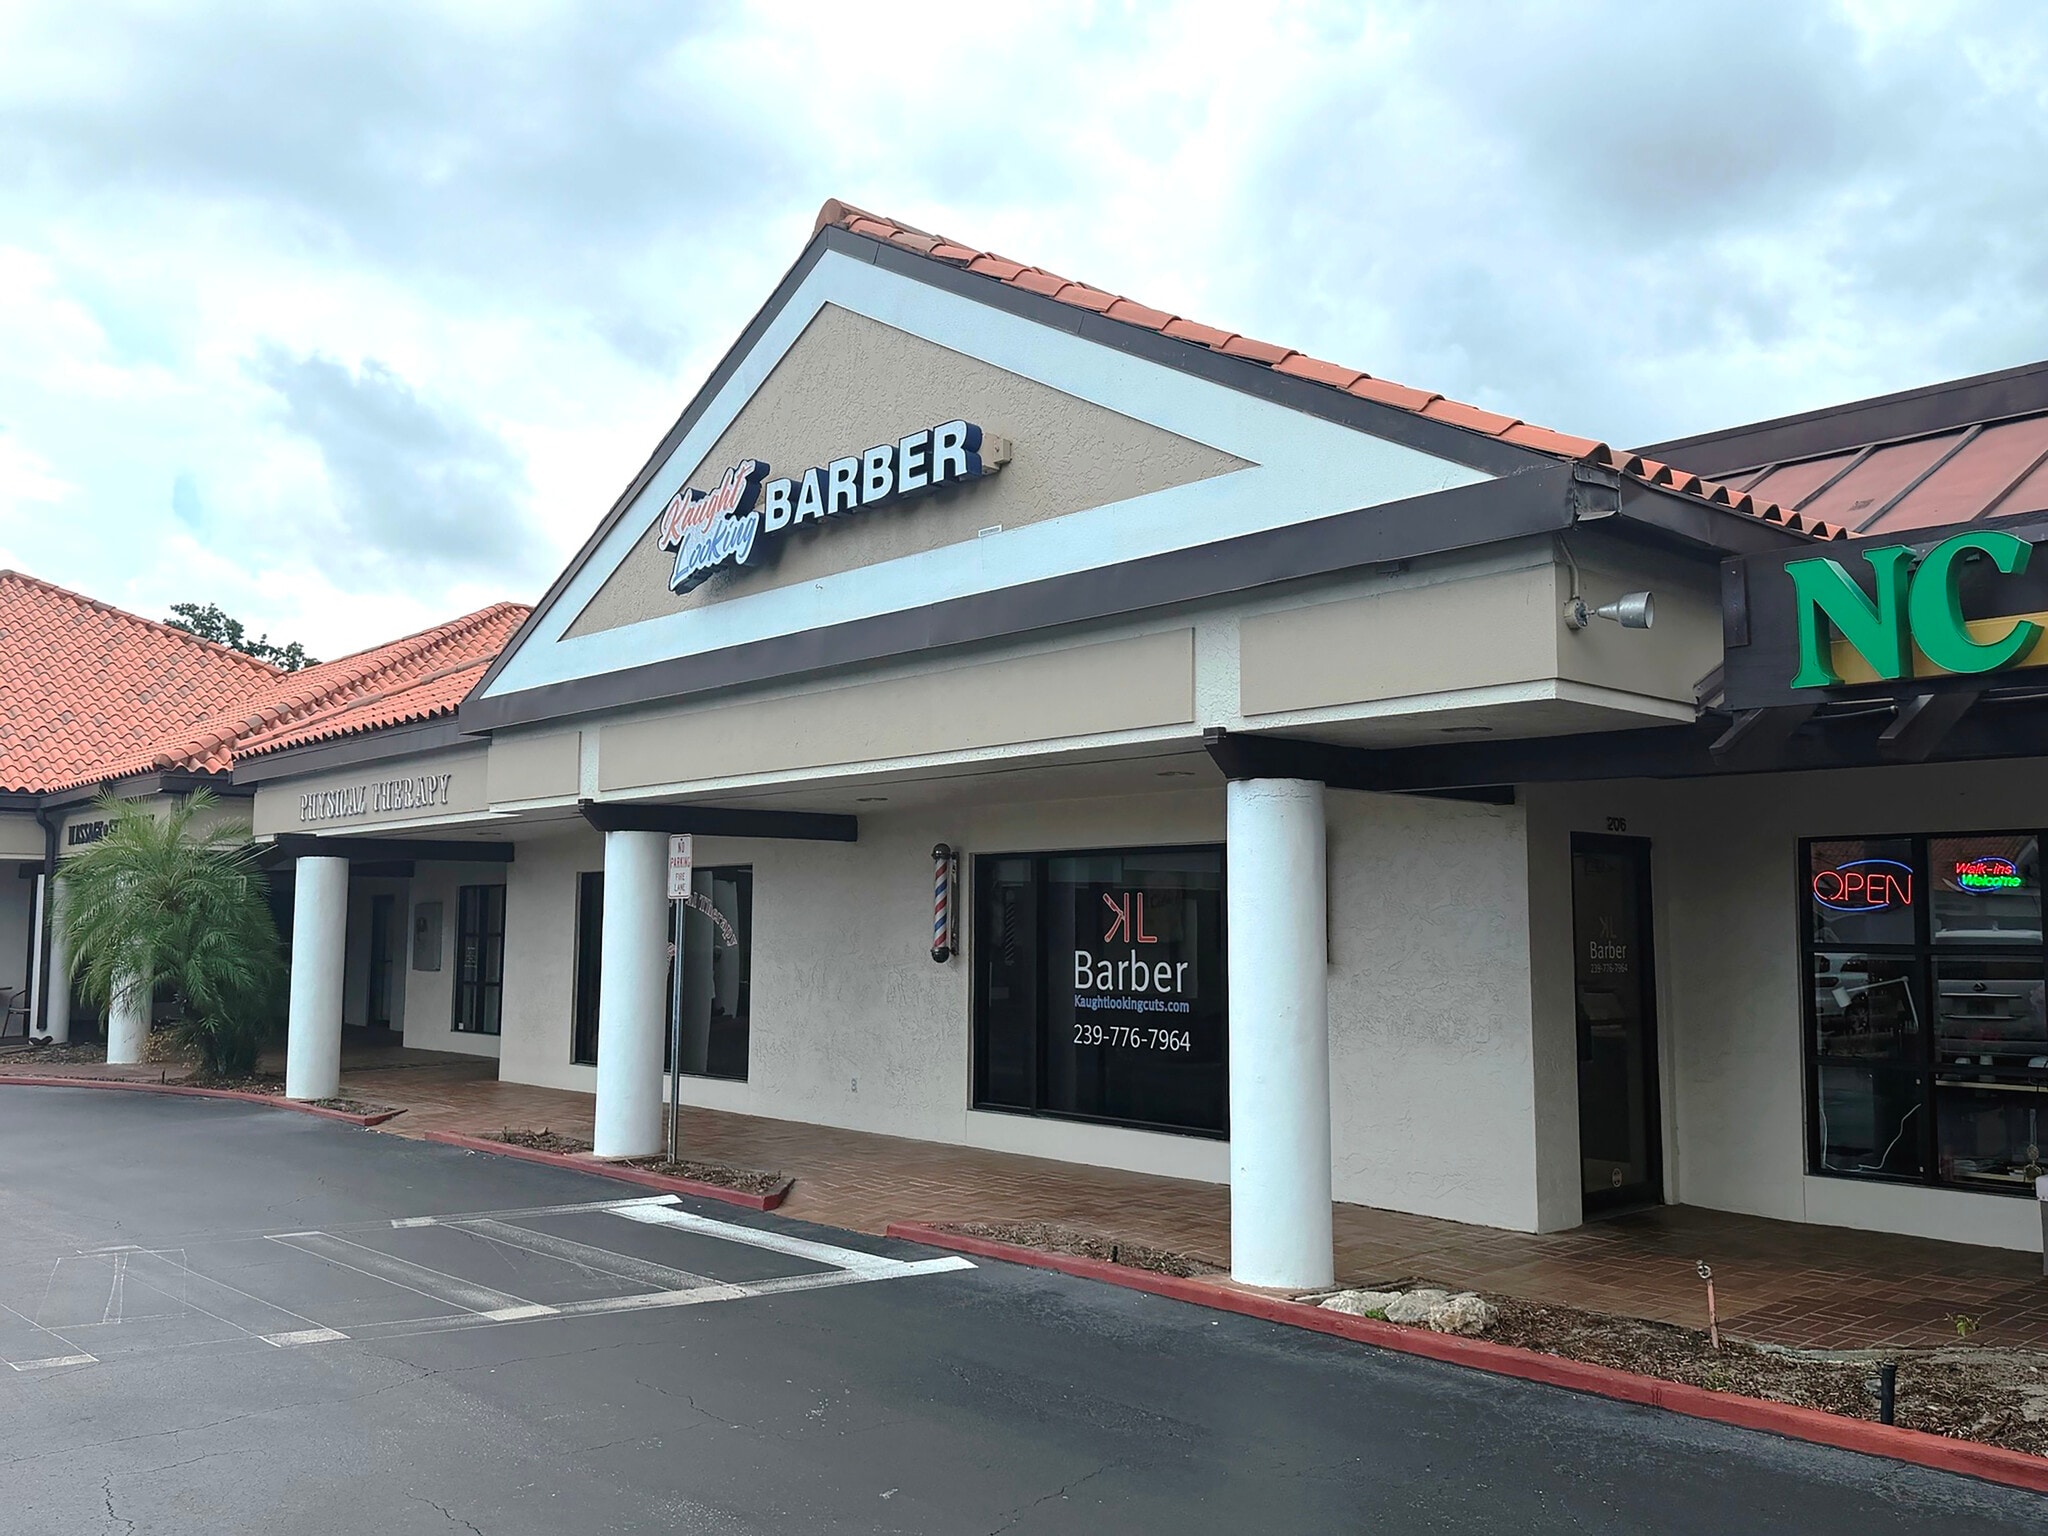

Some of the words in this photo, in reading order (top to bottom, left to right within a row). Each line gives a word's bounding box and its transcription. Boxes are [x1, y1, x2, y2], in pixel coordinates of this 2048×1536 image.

[765, 419, 968, 532] BARBER
[659, 460, 756, 549] Kaught
[670, 511, 759, 588] Looking
[1784, 529, 2034, 688] NC
[300, 785, 366, 822] PHYSICAL
[372, 773, 452, 812] THERAPY
[1606, 816, 1627, 831] 206
[677, 841, 685, 853] NO
[670, 856, 691, 868] PARKING
[1956, 862, 2013, 875] Walk-ins
[674, 883, 686, 892] LANE
[1813, 871, 1912, 905] OPEN
[1962, 874, 2022, 888] Welcome
[698, 894, 738, 947] Therapy
[1590, 940, 1627, 959] Barber
[1074, 949, 1189, 993] Barber
[1074, 995, 1190, 1014] Kaughtlookingcuts.com
[1073, 1024, 1191, 1052] 239-776-7964
